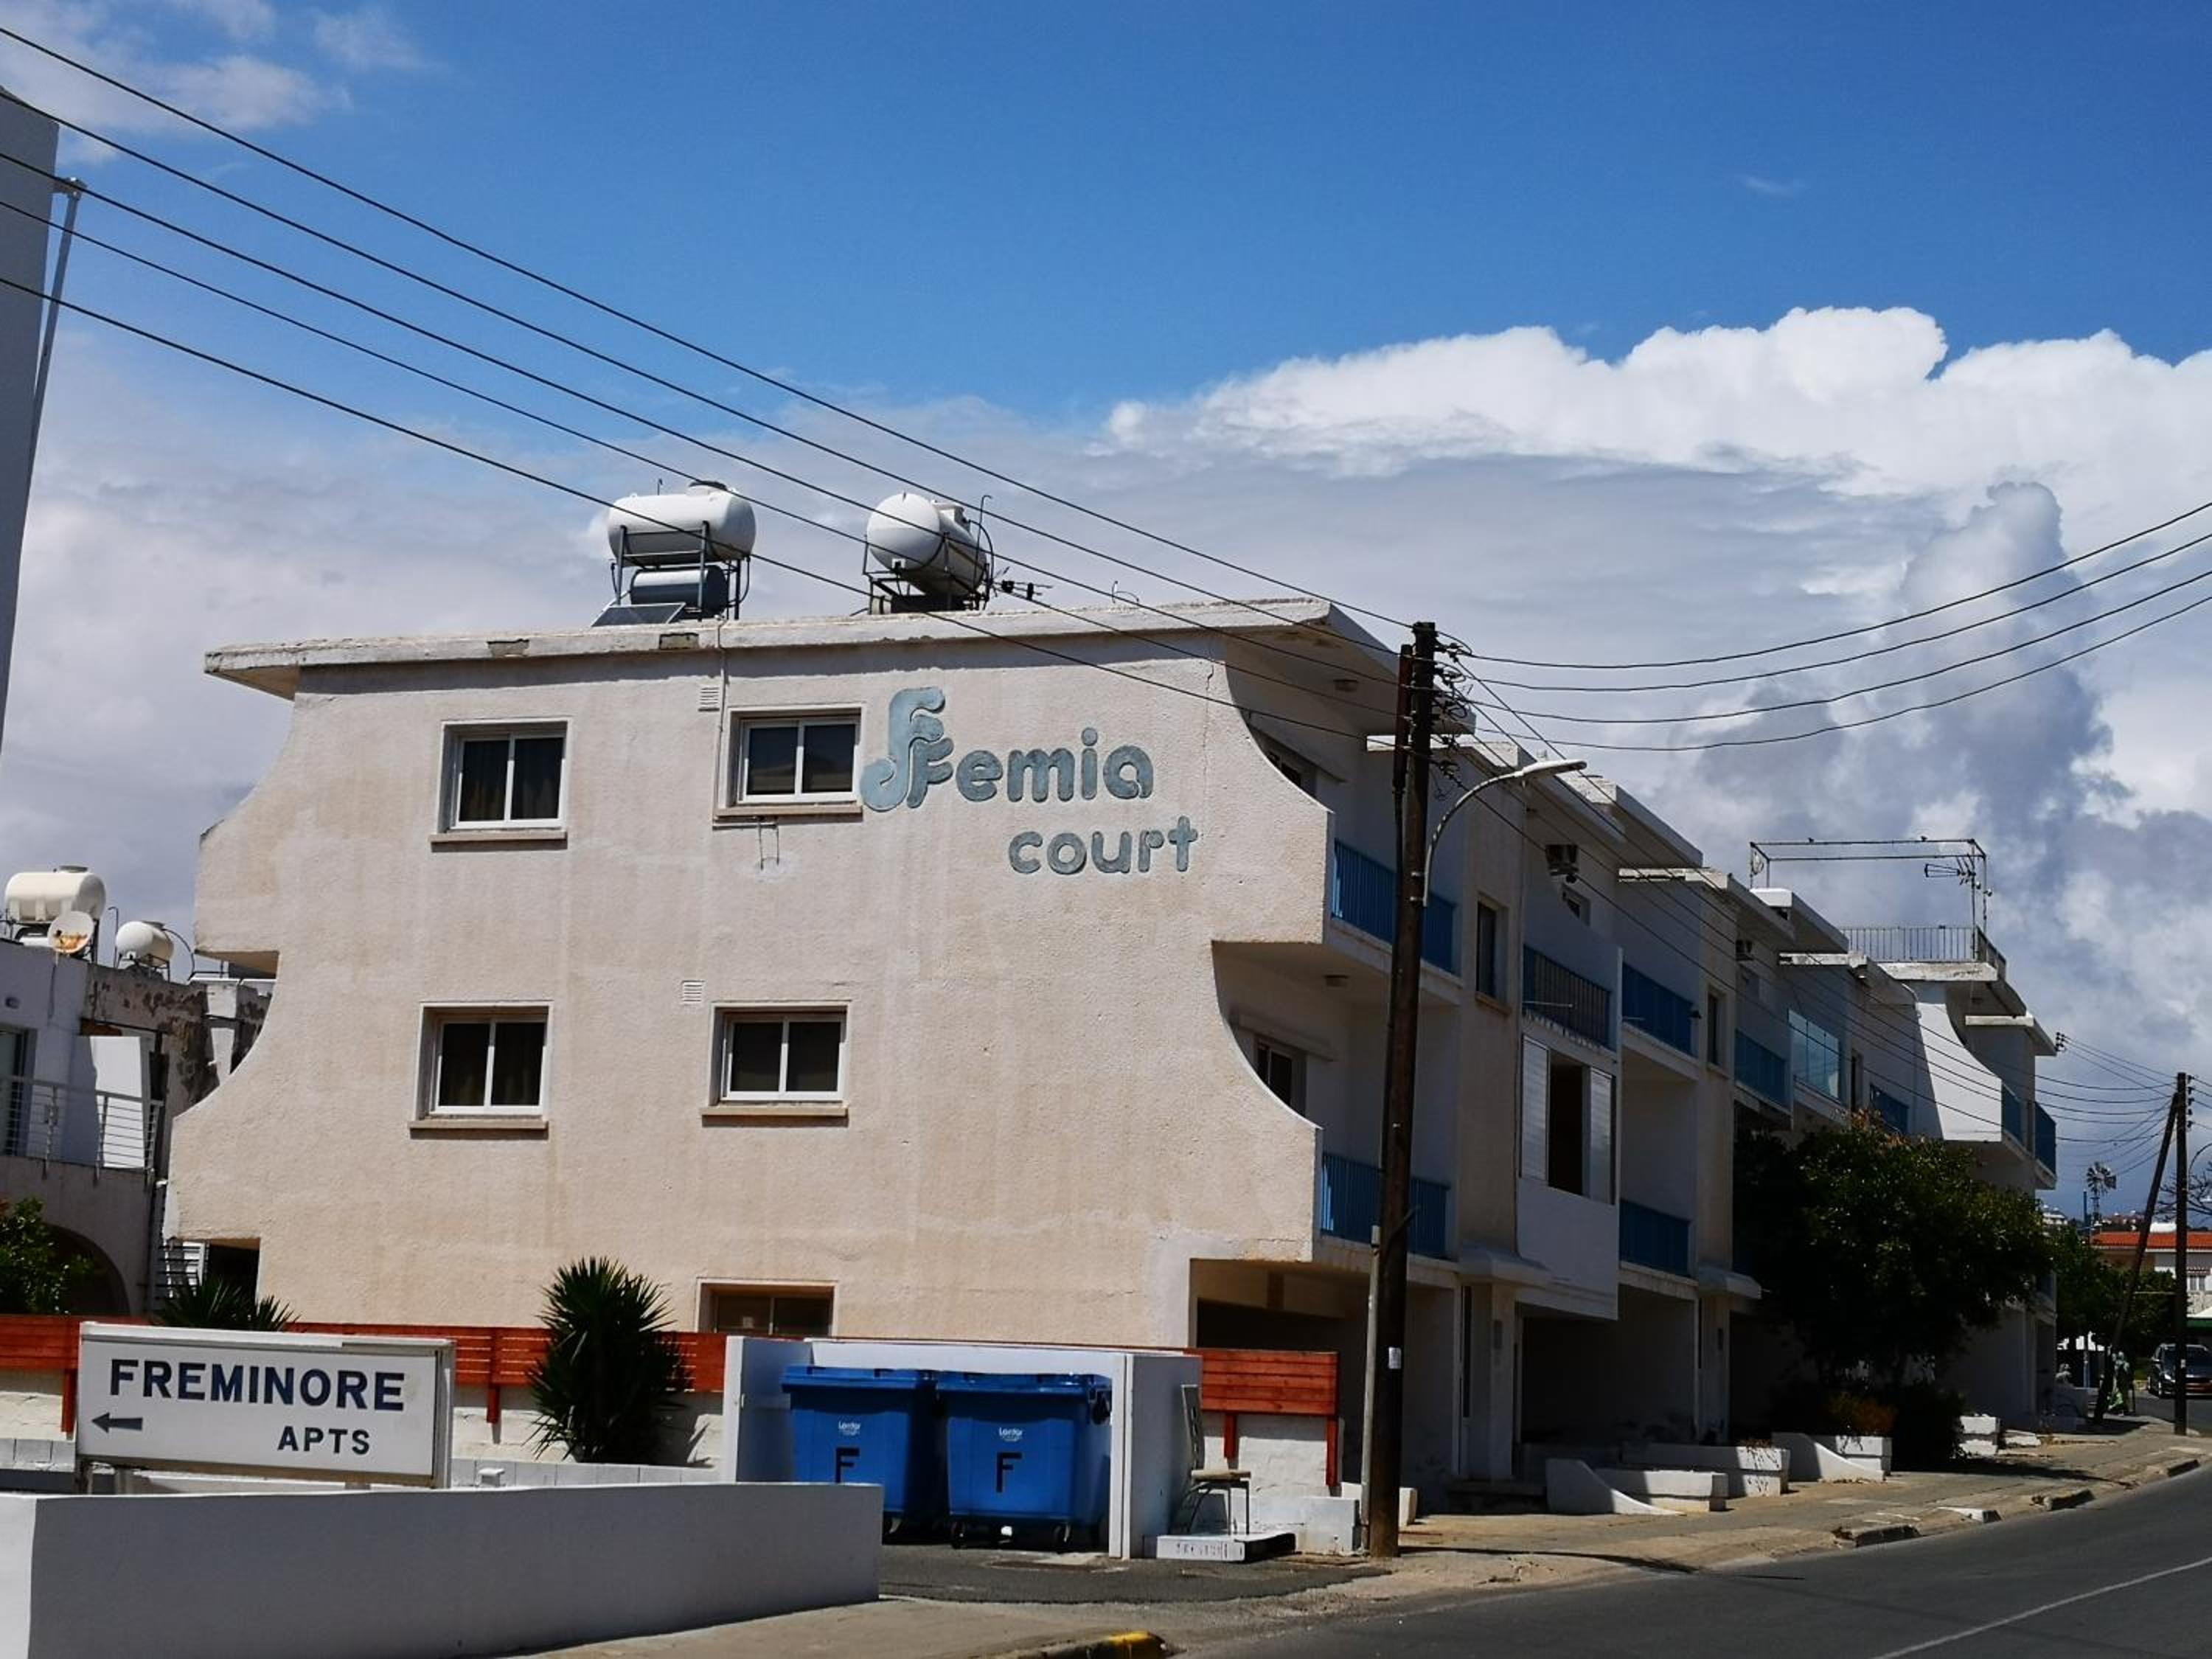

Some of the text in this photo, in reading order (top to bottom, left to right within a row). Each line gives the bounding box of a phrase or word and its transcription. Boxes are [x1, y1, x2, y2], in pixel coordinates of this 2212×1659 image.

[1009, 816, 1197, 874] court
[110, 1359, 405, 1411] FREMINORE
[277, 1426, 370, 1455] APTS
[835, 1447, 860, 1483] F
[996, 1453, 1022, 1492] F
